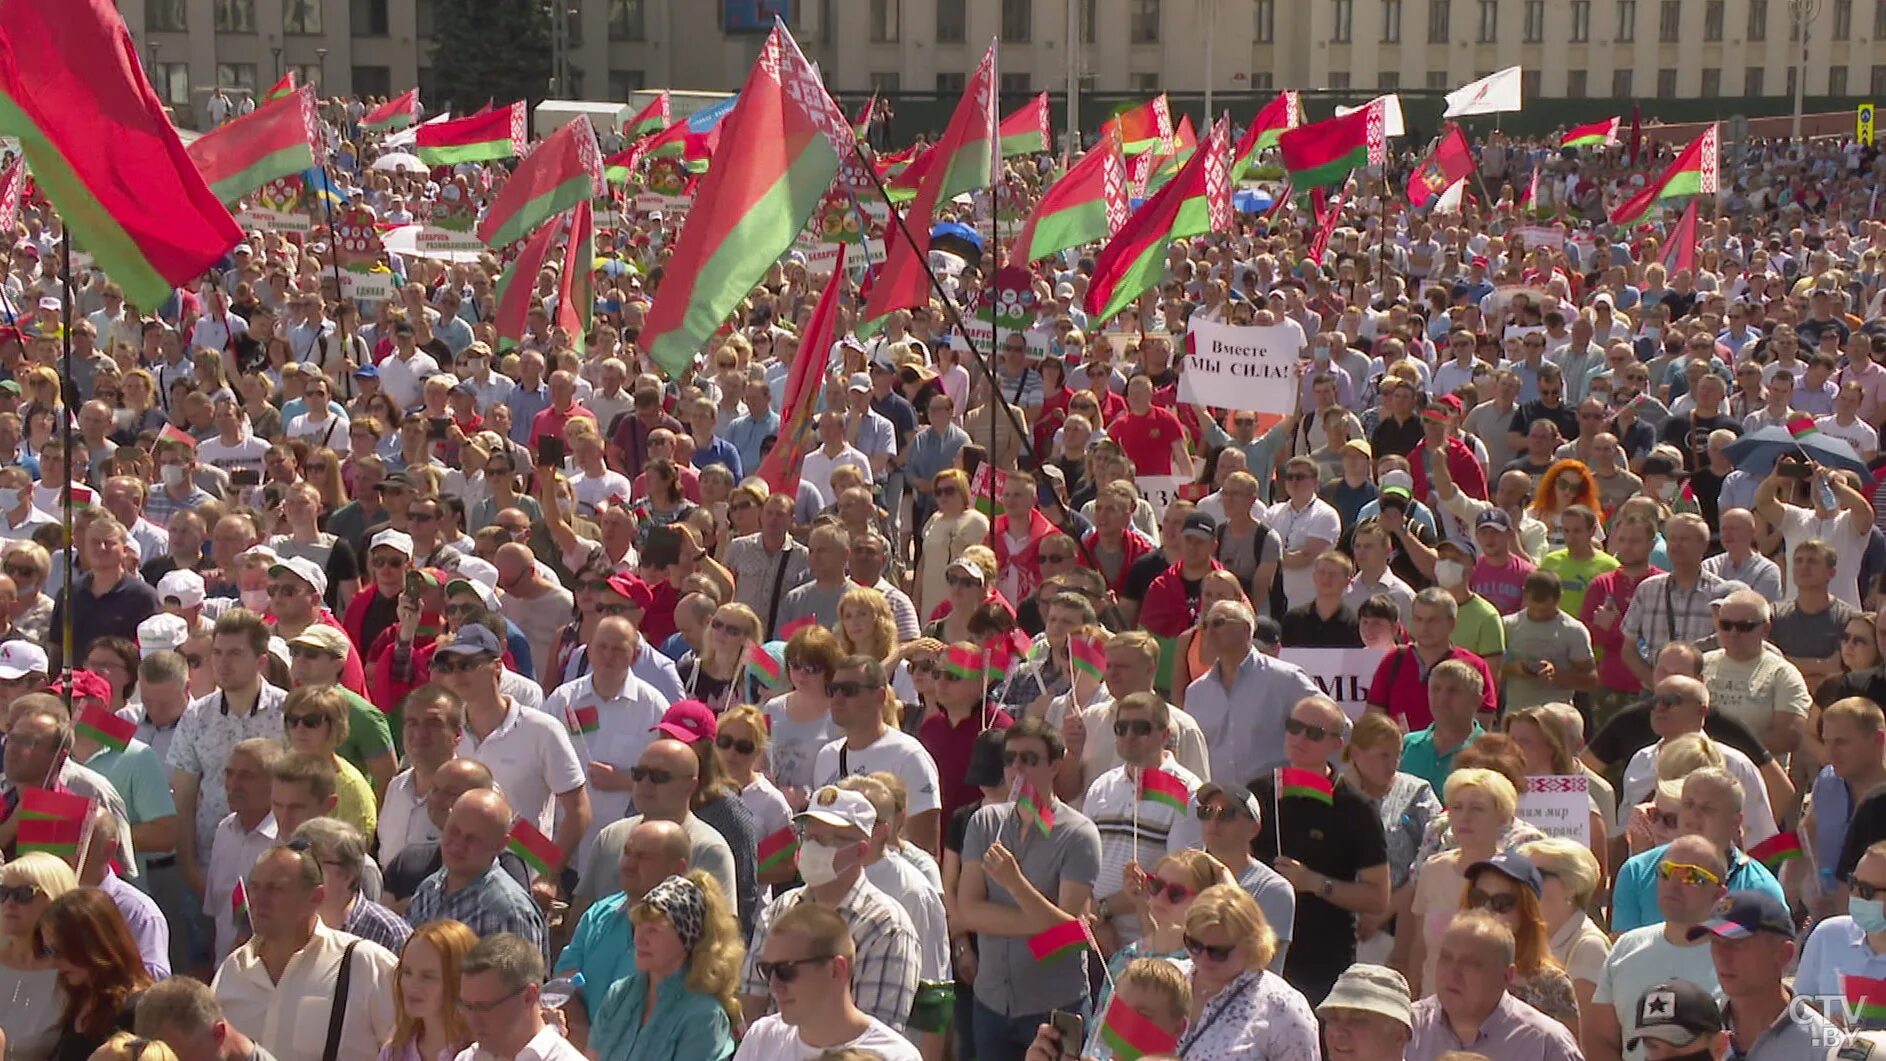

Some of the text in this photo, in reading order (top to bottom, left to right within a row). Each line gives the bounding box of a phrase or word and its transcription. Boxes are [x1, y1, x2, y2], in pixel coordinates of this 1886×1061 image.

[954, 327, 992, 339] БАРУС
[1212, 340, 1267, 357] Вместе
[1191, 356, 1288, 378] МЫ СИЛА!
[1518, 807, 1569, 820] ним мир
[1541, 823, 1584, 838] тране!
